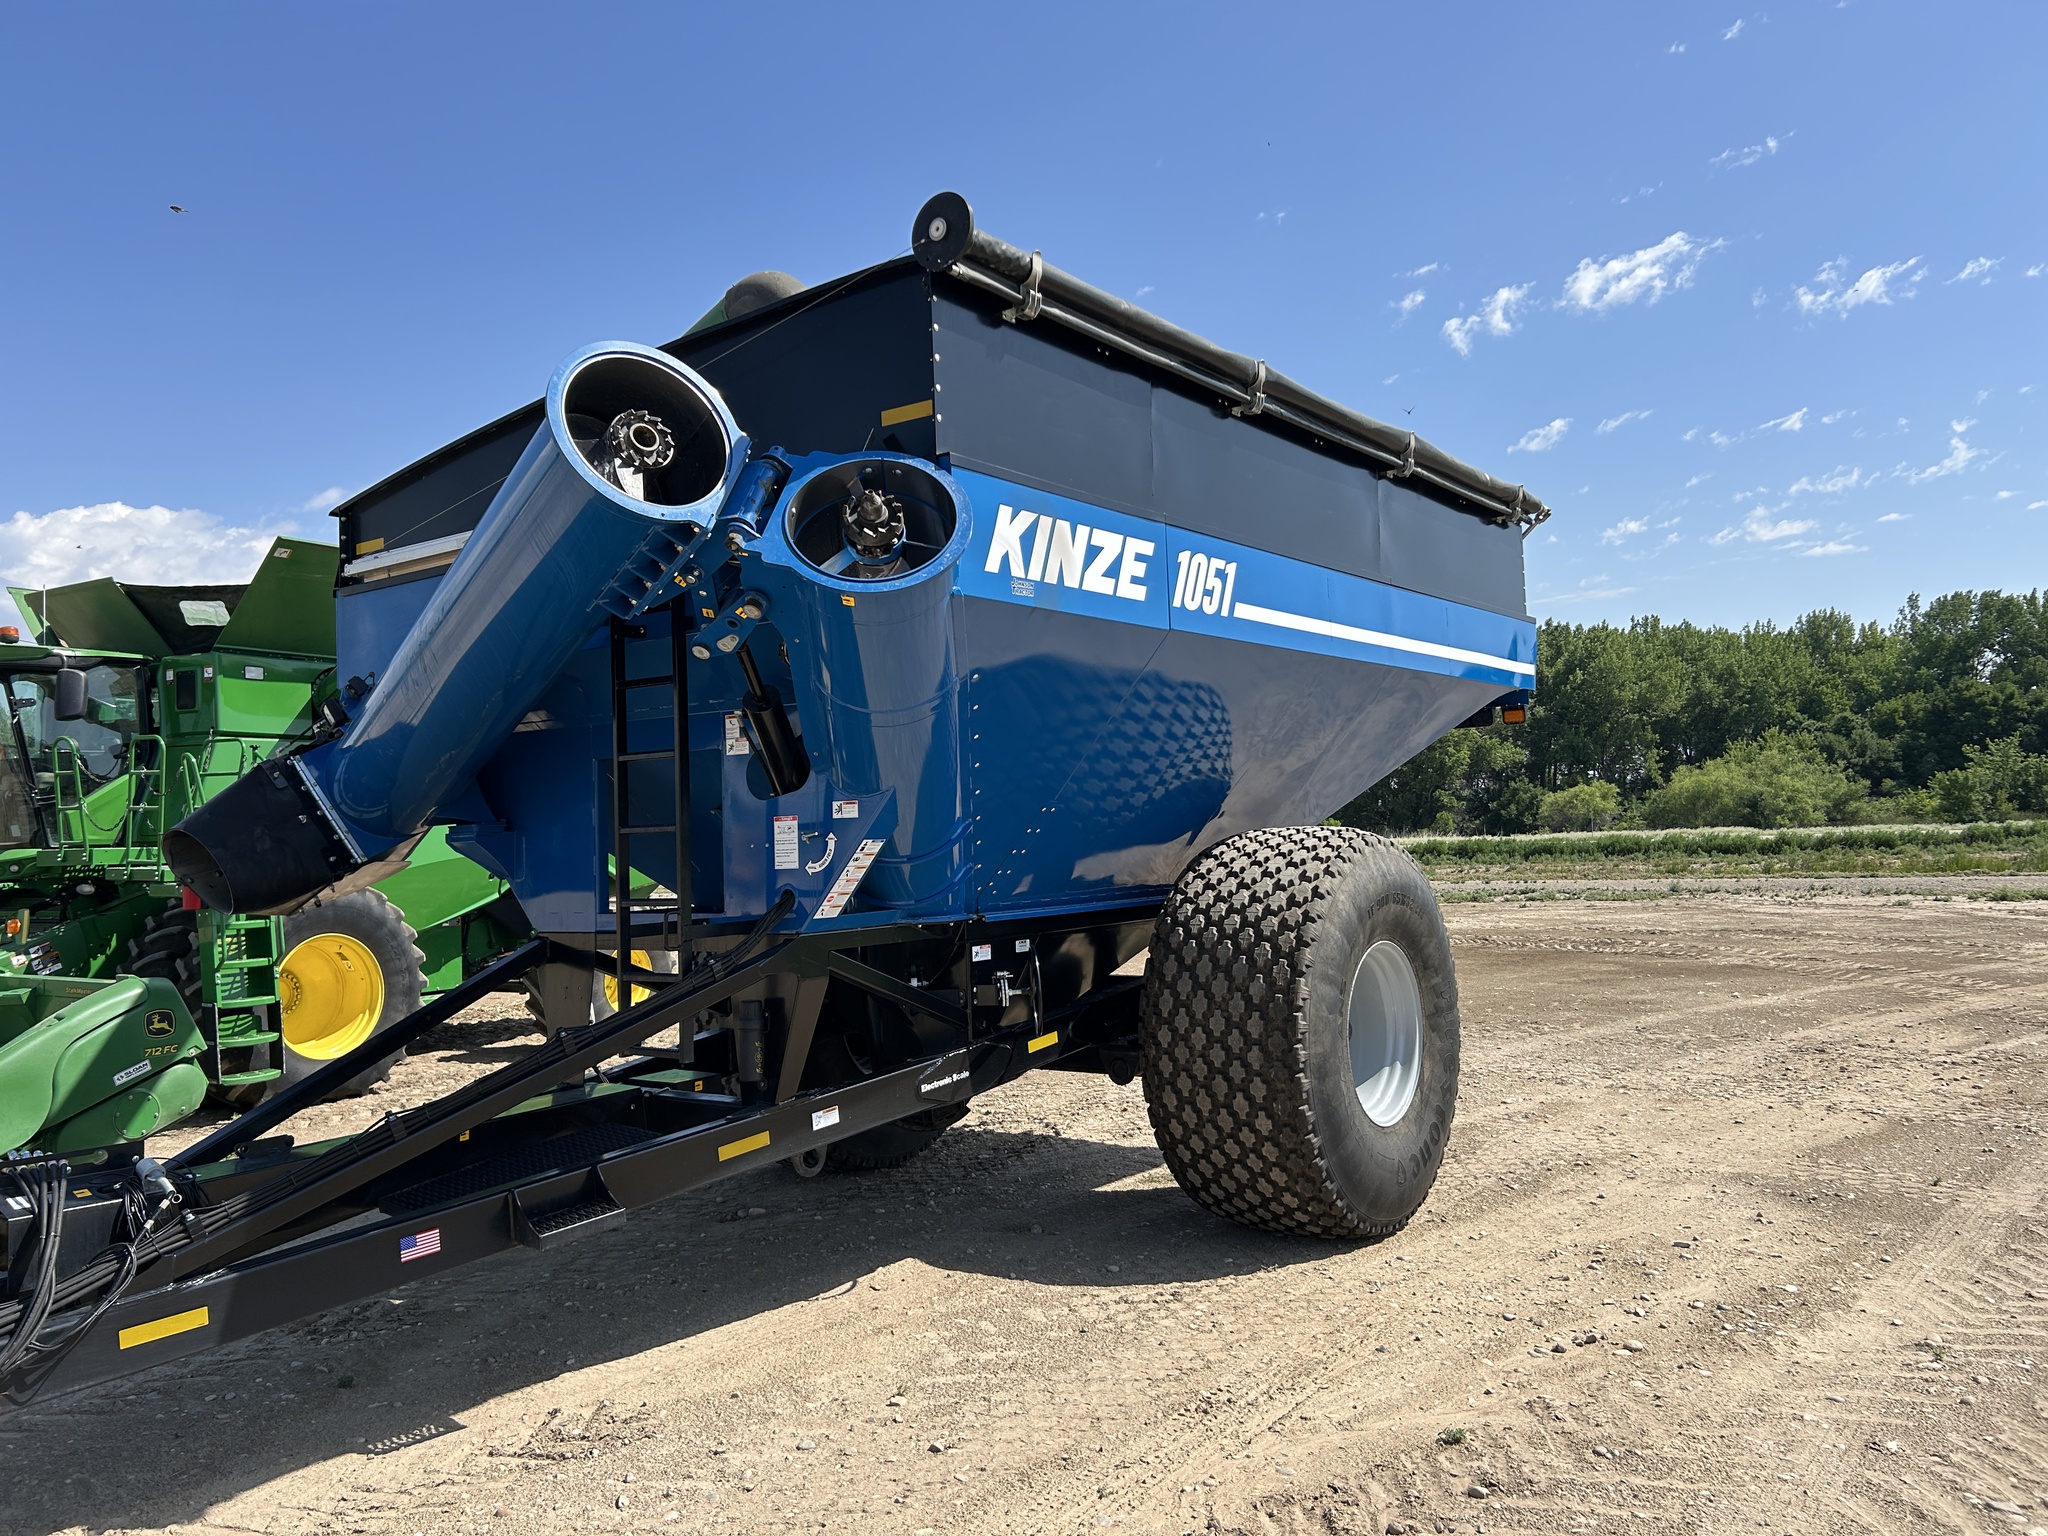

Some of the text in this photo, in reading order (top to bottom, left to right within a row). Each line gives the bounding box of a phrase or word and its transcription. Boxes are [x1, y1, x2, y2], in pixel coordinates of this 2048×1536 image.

[984, 503, 1155, 602] KINZE
[1172, 549, 1237, 617] 1051
[144, 1045, 179, 1057] 712 FC
[124, 1062, 148, 1077] SLOAN
[921, 1070, 970, 1093] Electronic Scale
